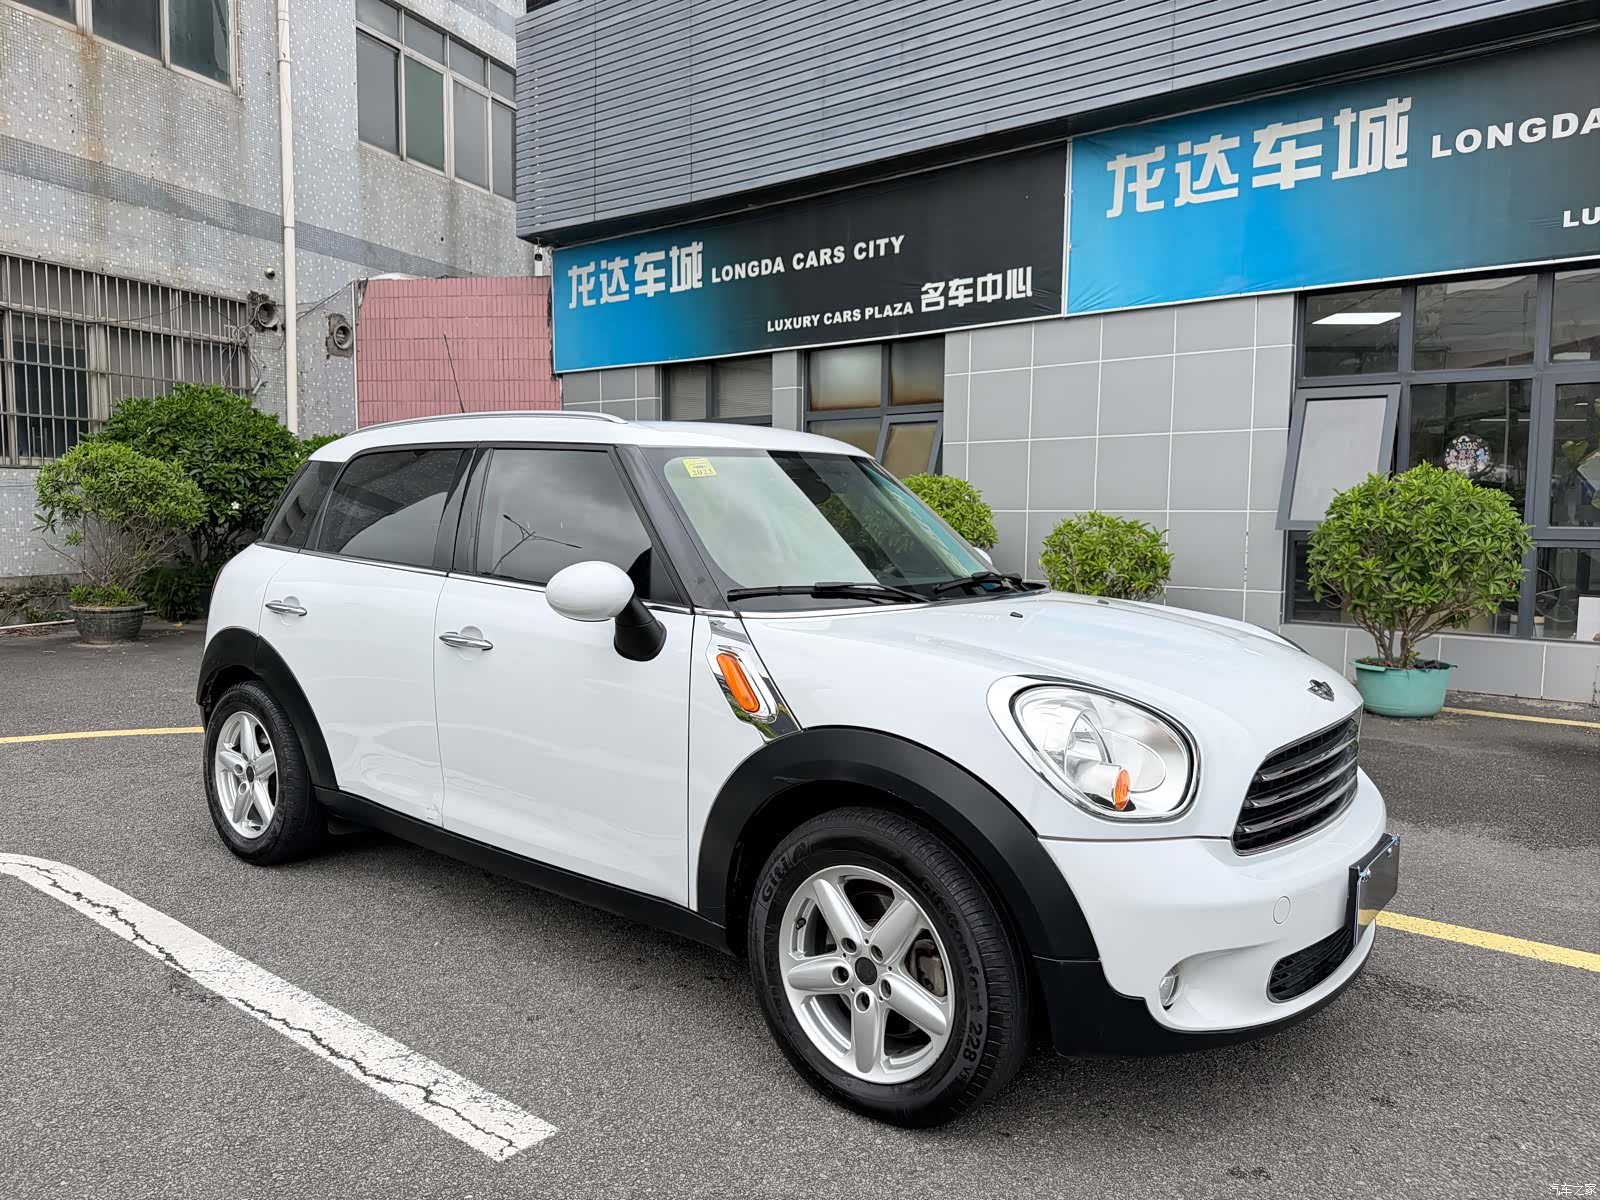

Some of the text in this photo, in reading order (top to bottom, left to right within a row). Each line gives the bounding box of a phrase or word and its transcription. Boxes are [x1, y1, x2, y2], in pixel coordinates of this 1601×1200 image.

[1105, 96, 1412, 219] 龙达车城
[1431, 107, 1600, 159] LONGDA
[568, 240, 704, 309] 龙达车城
[711, 234, 905, 284] LONGDA CARS CITY
[920, 266, 1032, 313] 名车中心
[767, 301, 914, 333] LUXURY CARS PLAZA
[963, 1023, 983, 1063] 228
